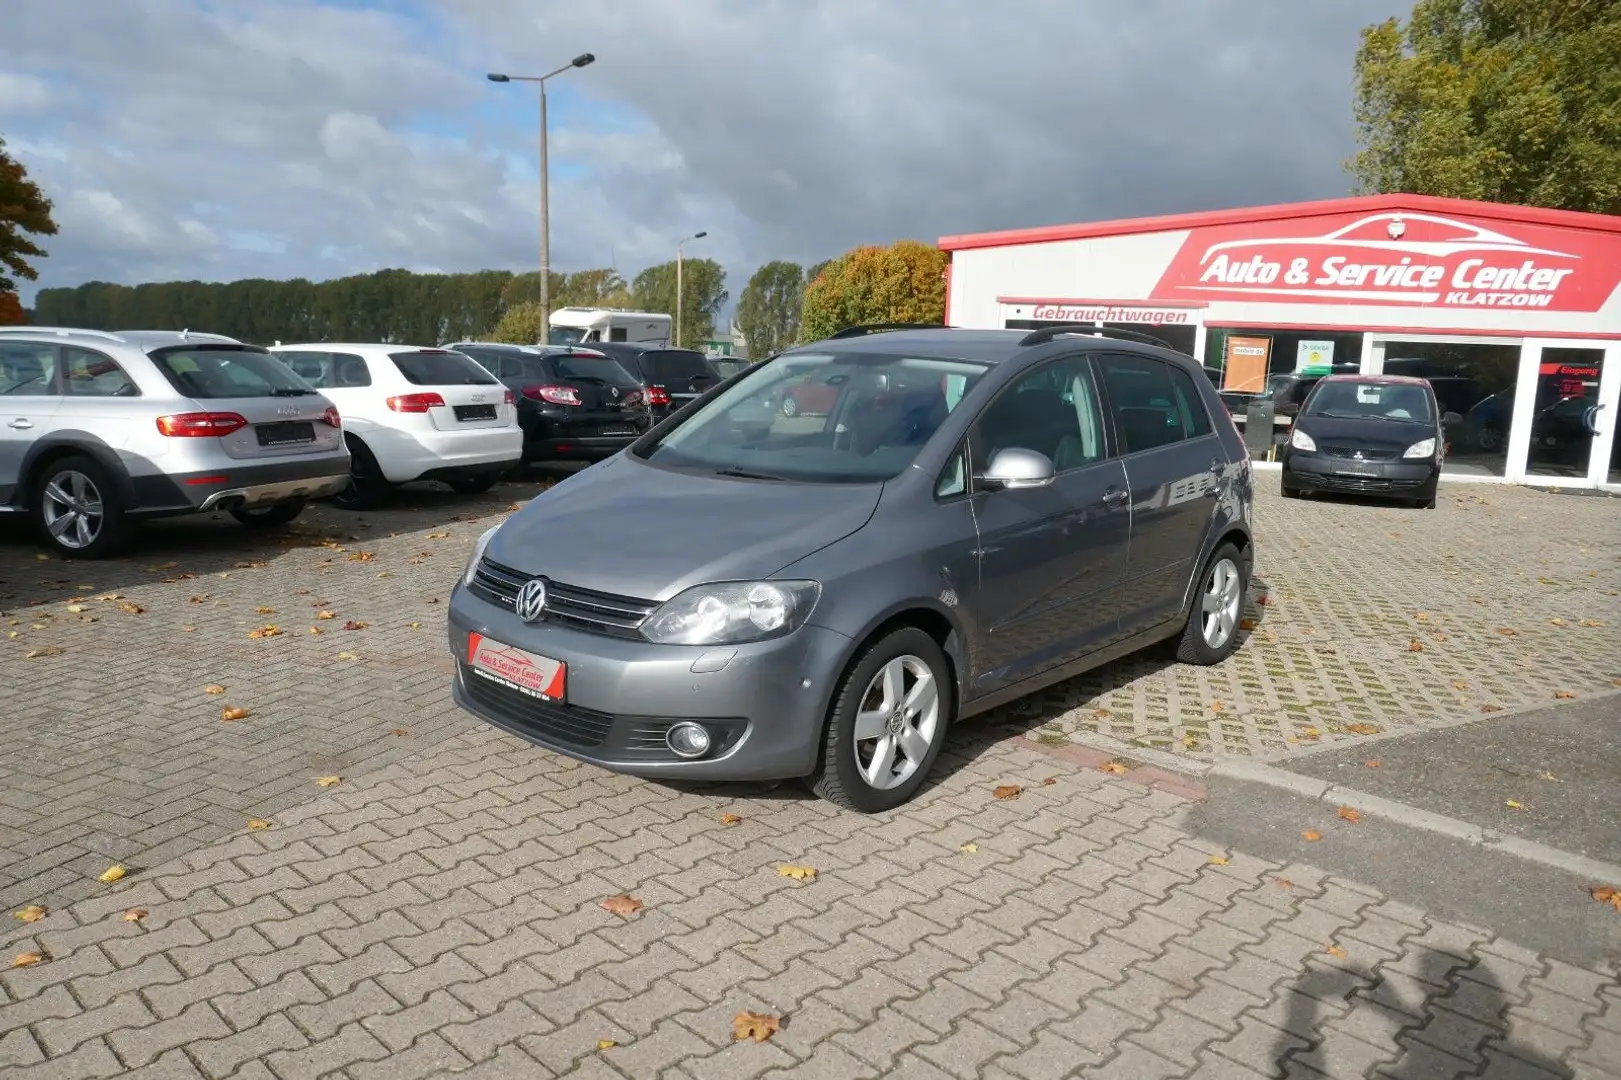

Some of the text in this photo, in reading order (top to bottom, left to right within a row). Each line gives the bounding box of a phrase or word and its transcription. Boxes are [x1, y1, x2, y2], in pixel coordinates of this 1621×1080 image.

[1200, 254, 1574, 291] Auto & Service Center
[1444, 292, 1554, 307] KLATZOW
[1033, 304, 1188, 327] Gebrauchtwagen
[1560, 366, 1598, 377] Eingang
[497, 659, 521, 676] Service
[521, 667, 545, 682] Center
